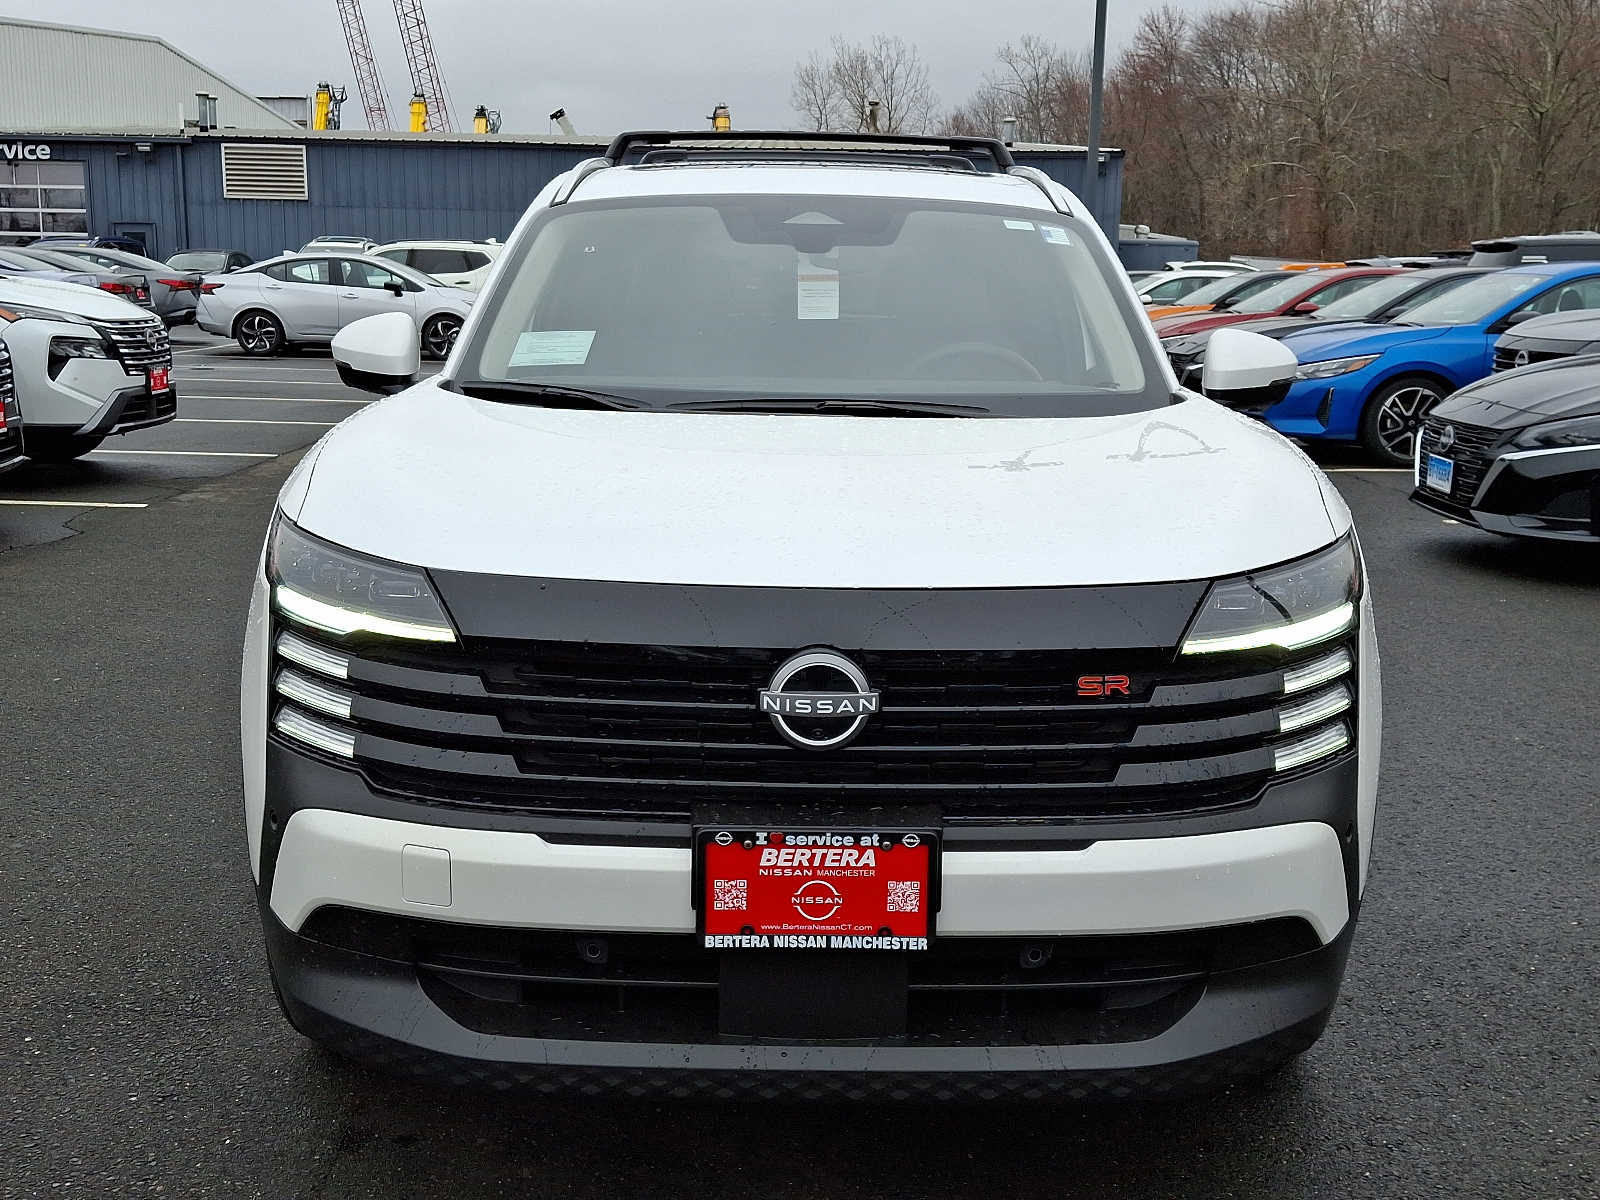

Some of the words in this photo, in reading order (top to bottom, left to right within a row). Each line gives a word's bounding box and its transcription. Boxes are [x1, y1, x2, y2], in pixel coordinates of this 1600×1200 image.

[1078, 675, 1129, 696] SR
[763, 696, 876, 714] NISSAN
[756, 832, 768, 845] I
[785, 832, 855, 847] service
[860, 834, 880, 847] at
[760, 848, 876, 867] BERTERA
[817, 869, 876, 877] MANCHESTER
[792, 896, 843, 904] NISSAN
[761, 923, 873, 931] www.BerteraNissanCT.com
[705, 935, 770, 948] BERTERA
[773, 935, 827, 948] NISSAN
[830, 936, 928, 950] MANCHESTER
